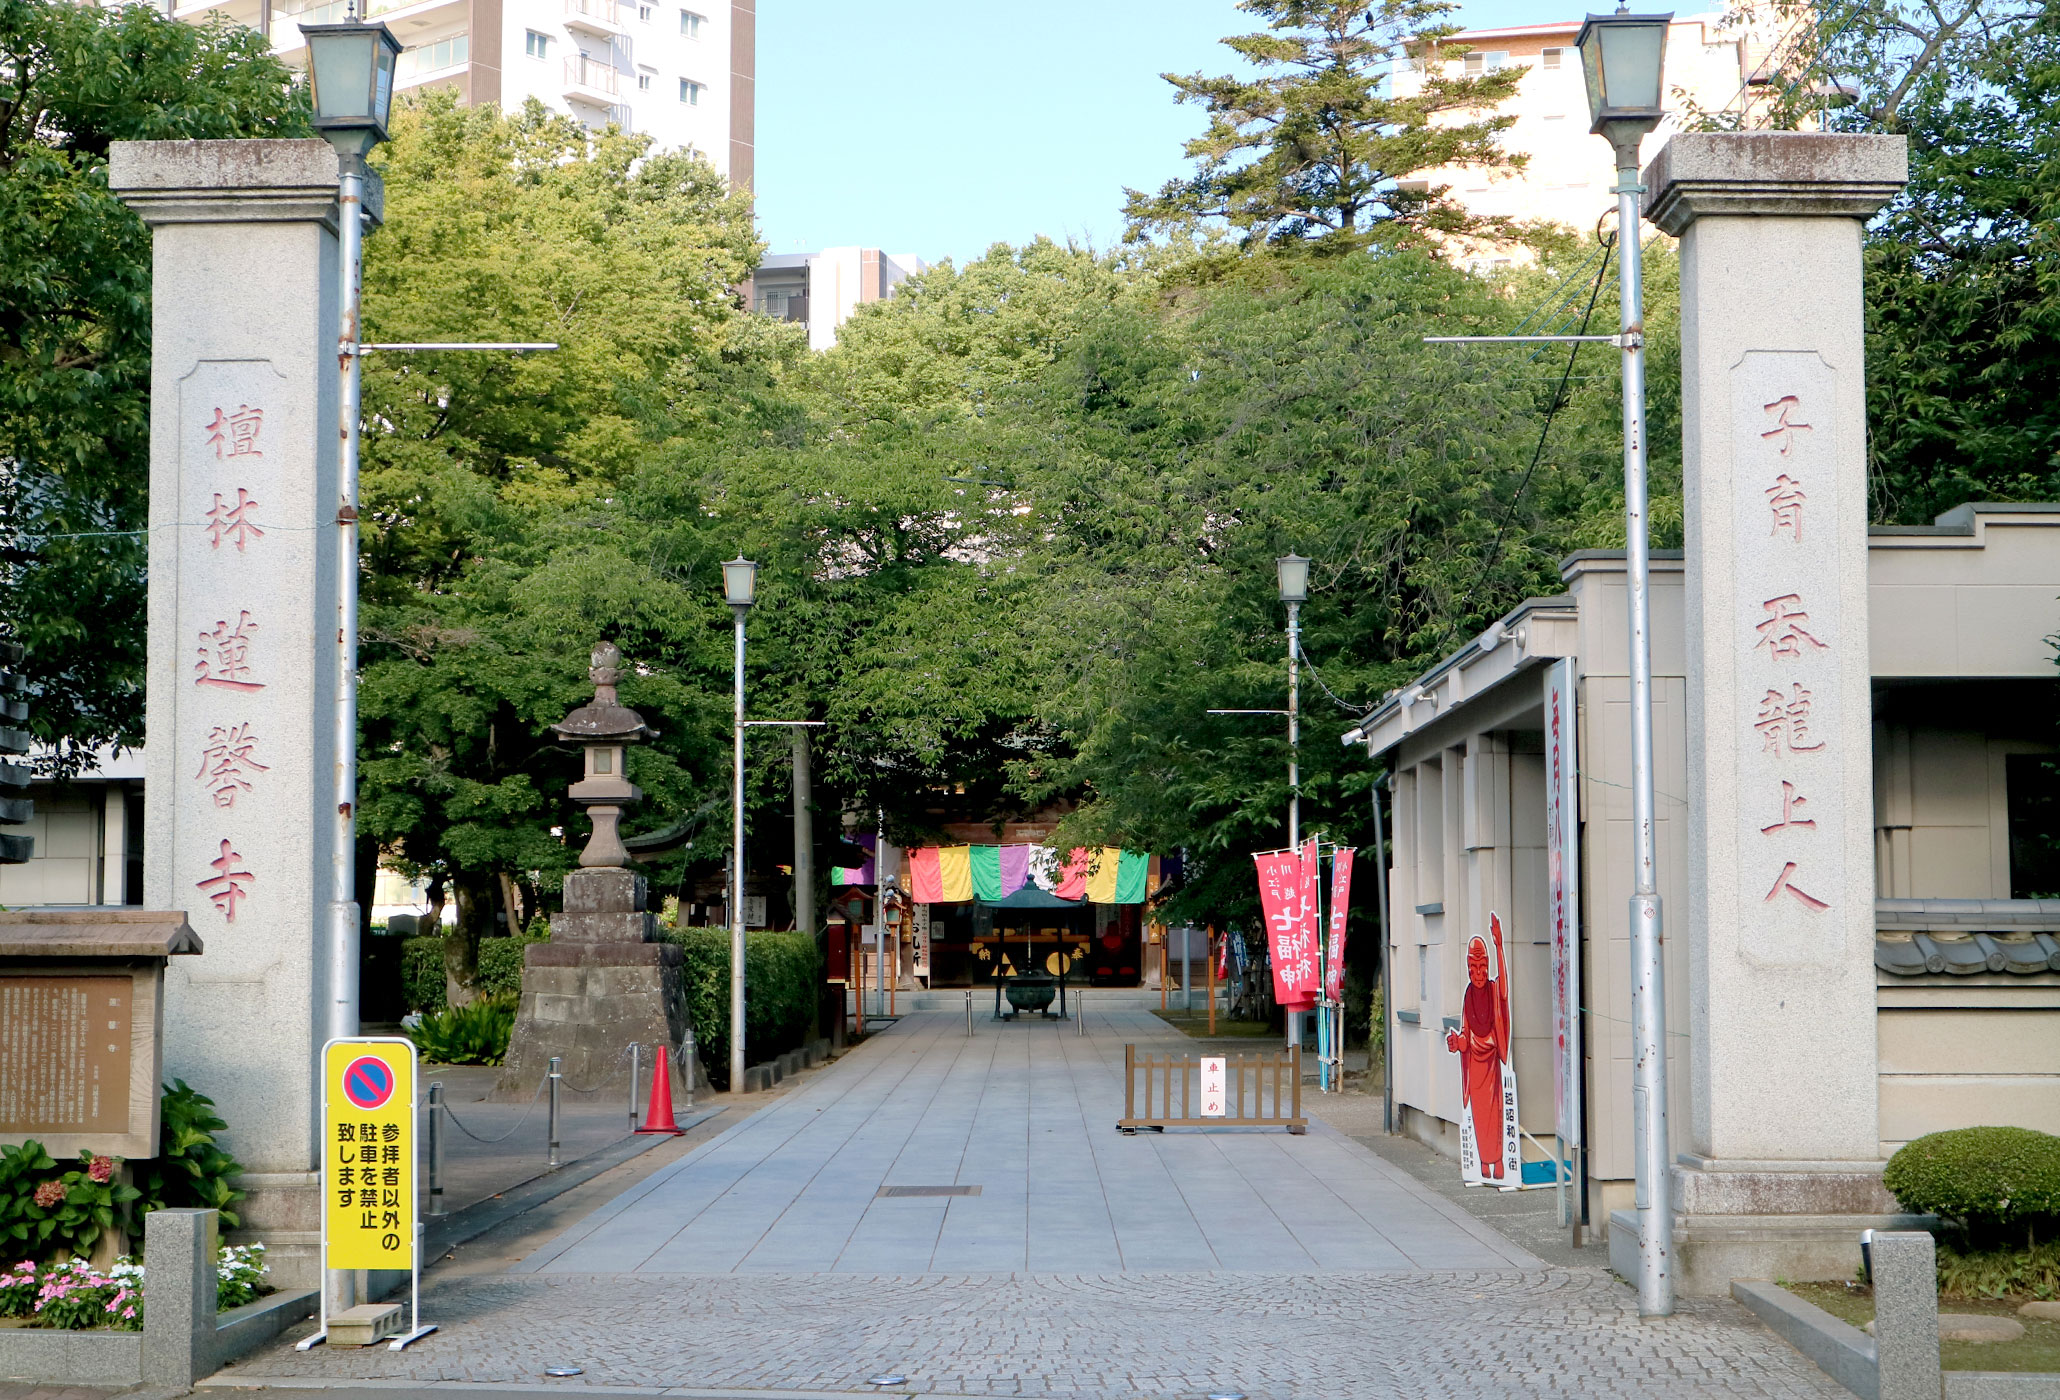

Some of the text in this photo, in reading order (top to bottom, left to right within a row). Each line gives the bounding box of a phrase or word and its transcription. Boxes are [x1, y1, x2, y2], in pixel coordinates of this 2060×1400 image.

[978, 948, 991, 961] 納
[1071, 947, 1084, 960] 奉
[1207, 1062, 1220, 1112] 車止め
[1503, 1076, 1518, 1172] 川越昭和の街
[337, 1123, 356, 1208] 致します
[359, 1123, 378, 1230] 駐車を禁止
[381, 1123, 400, 1251] 参拝者以外の
